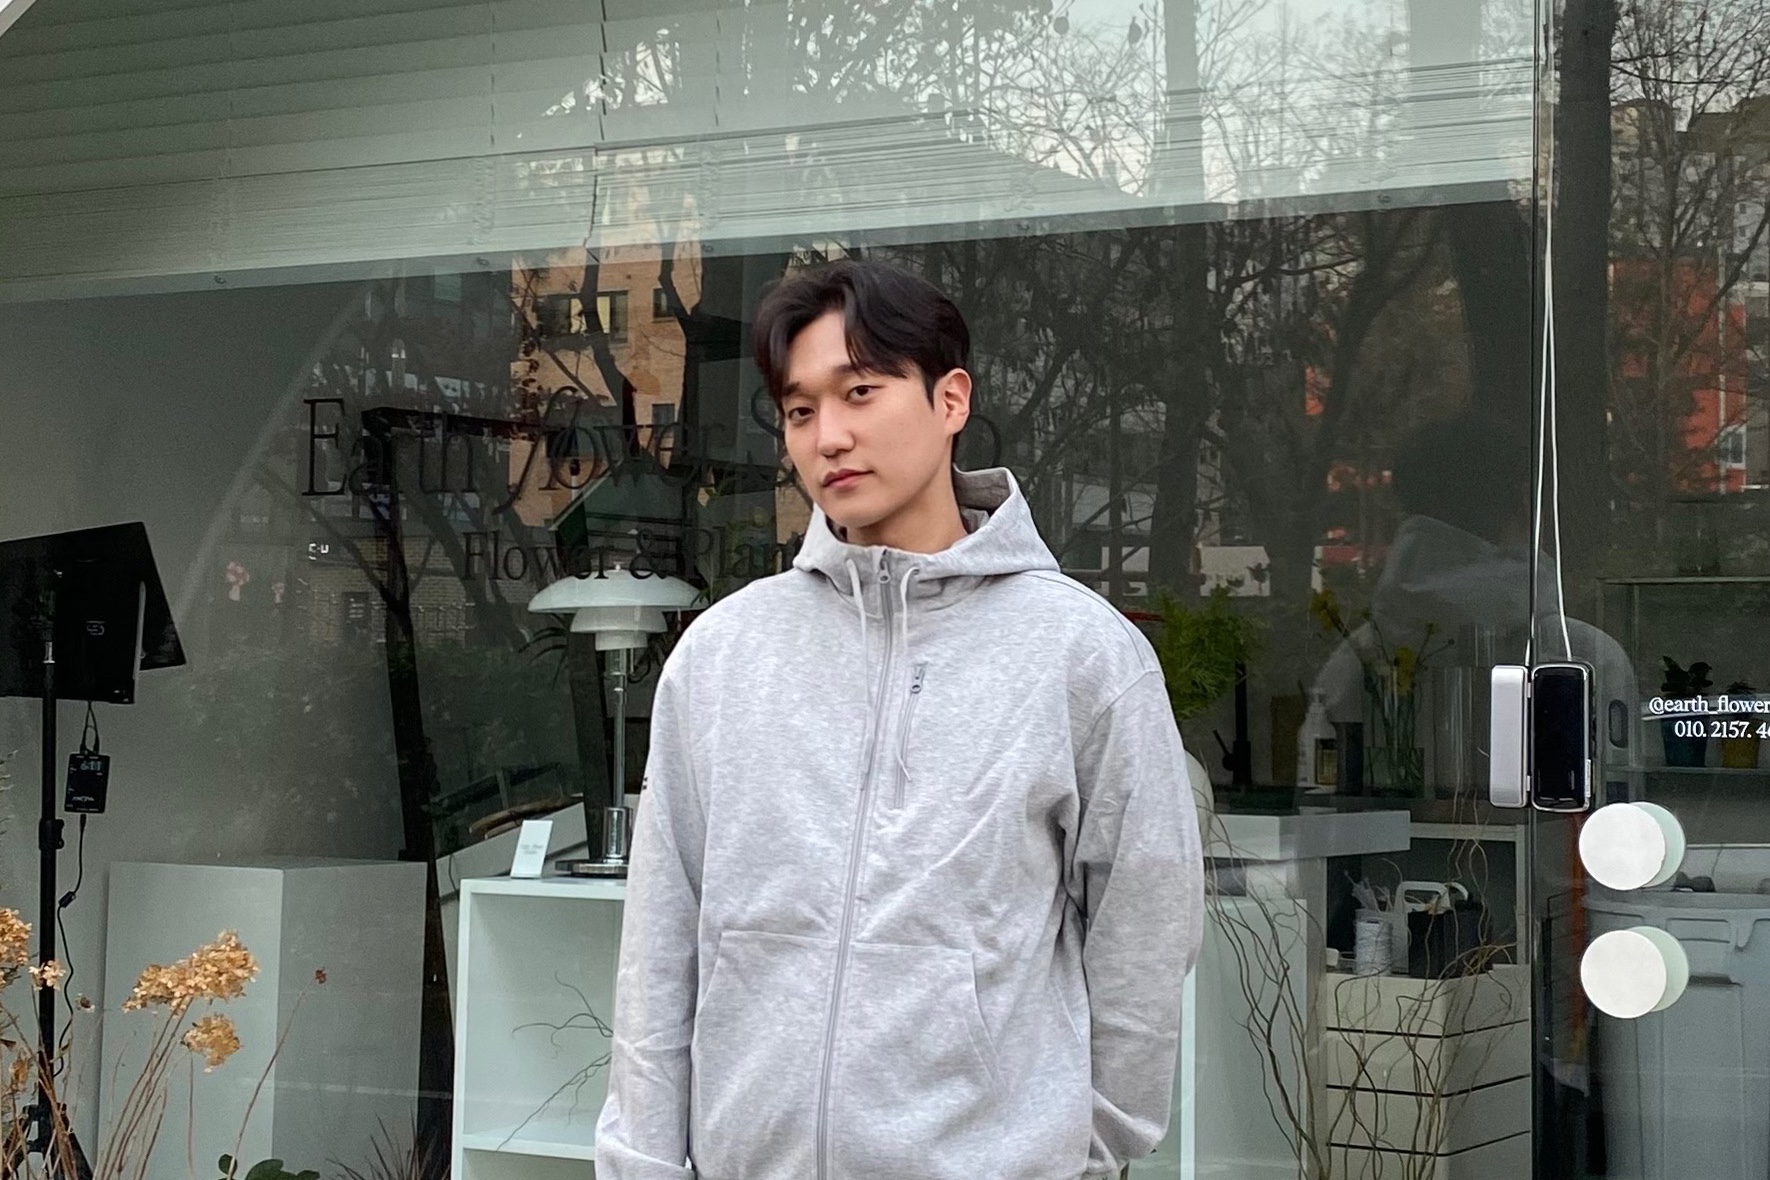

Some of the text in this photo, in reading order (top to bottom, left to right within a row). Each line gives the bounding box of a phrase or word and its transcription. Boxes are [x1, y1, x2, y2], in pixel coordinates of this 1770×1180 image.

[463, 530, 613, 580] Flower
[690, 526, 797, 580] Plan
[1675, 720, 1770, 739] 010. 2157. 4
